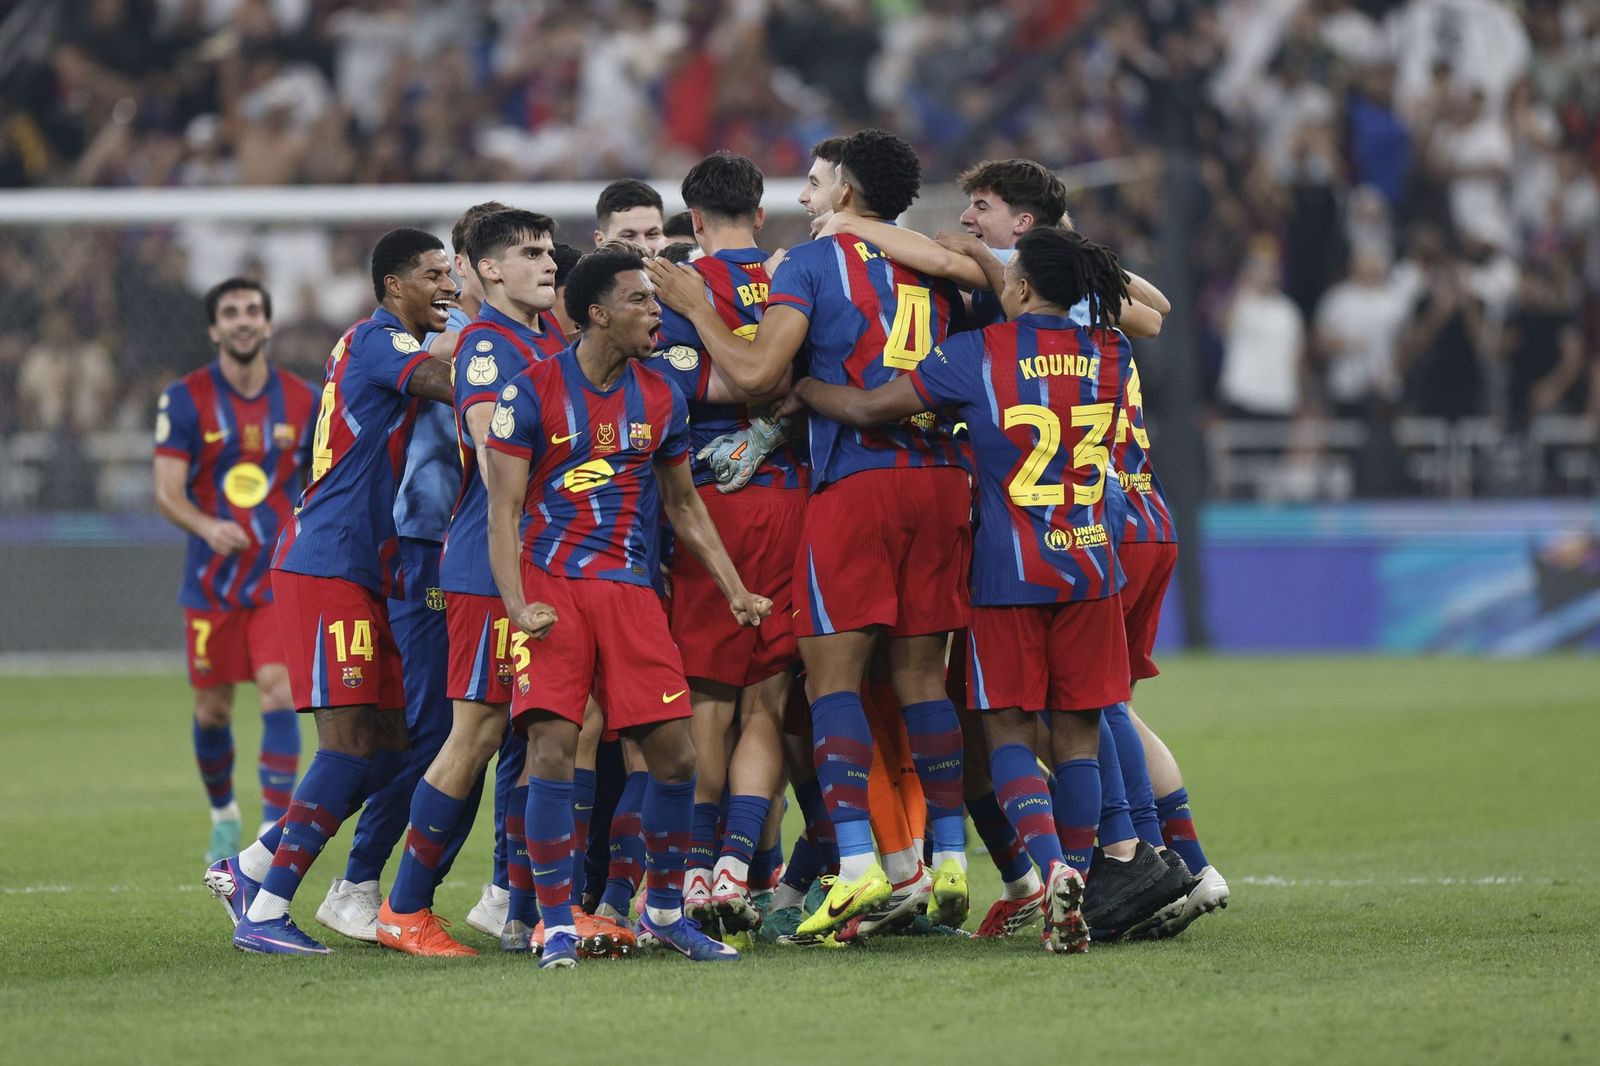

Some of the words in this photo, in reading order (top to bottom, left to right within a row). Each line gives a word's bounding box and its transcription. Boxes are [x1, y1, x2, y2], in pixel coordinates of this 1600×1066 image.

[883, 283, 932, 371] 4
[1019, 354, 1100, 380] KOUNDE
[1004, 402, 1115, 507] 23
[1073, 524, 1105, 537] UNHCR
[1075, 533, 1108, 546] ACNUR
[192, 618, 211, 657] 7
[328, 620, 374, 662] 14
[511, 631, 531, 673] 3
